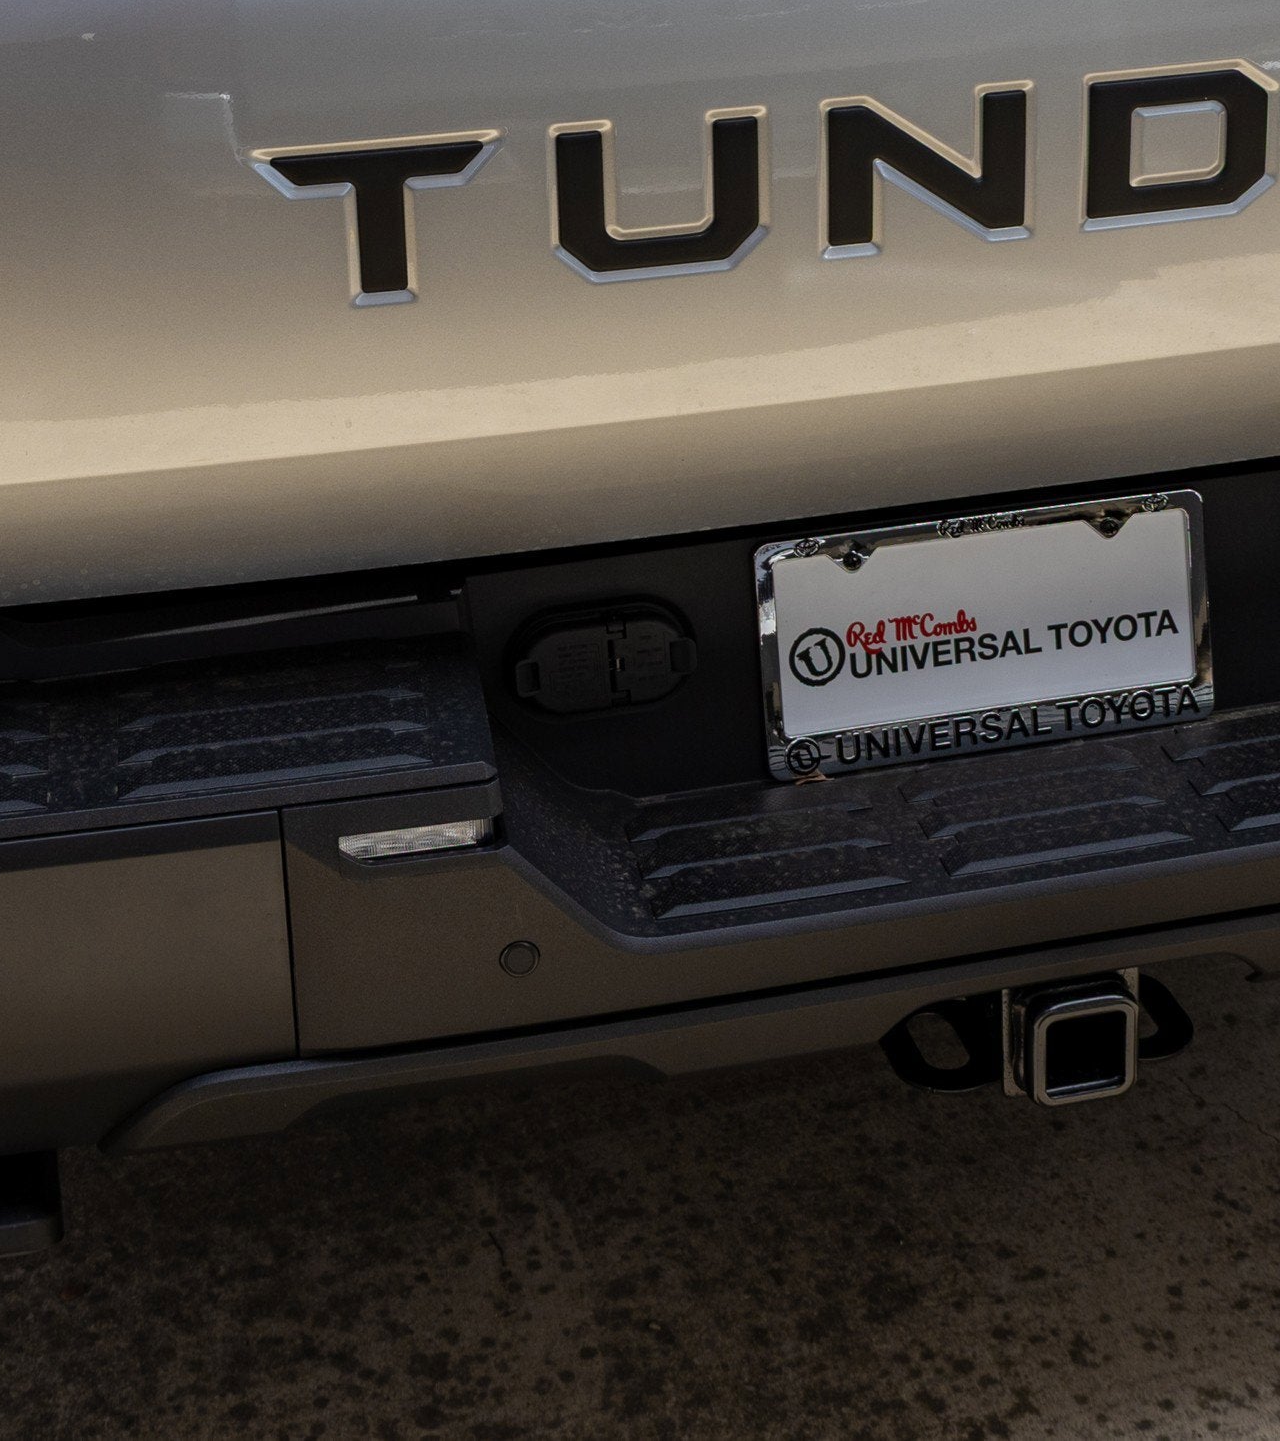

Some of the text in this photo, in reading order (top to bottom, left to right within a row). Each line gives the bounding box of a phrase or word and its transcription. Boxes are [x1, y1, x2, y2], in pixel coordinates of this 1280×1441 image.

[846, 609, 977, 654] Red McCombs
[849, 609, 1179, 679] UNIVERSAL TOYOTA
[835, 684, 1201, 764] UNIVERSAL TOYOTA
